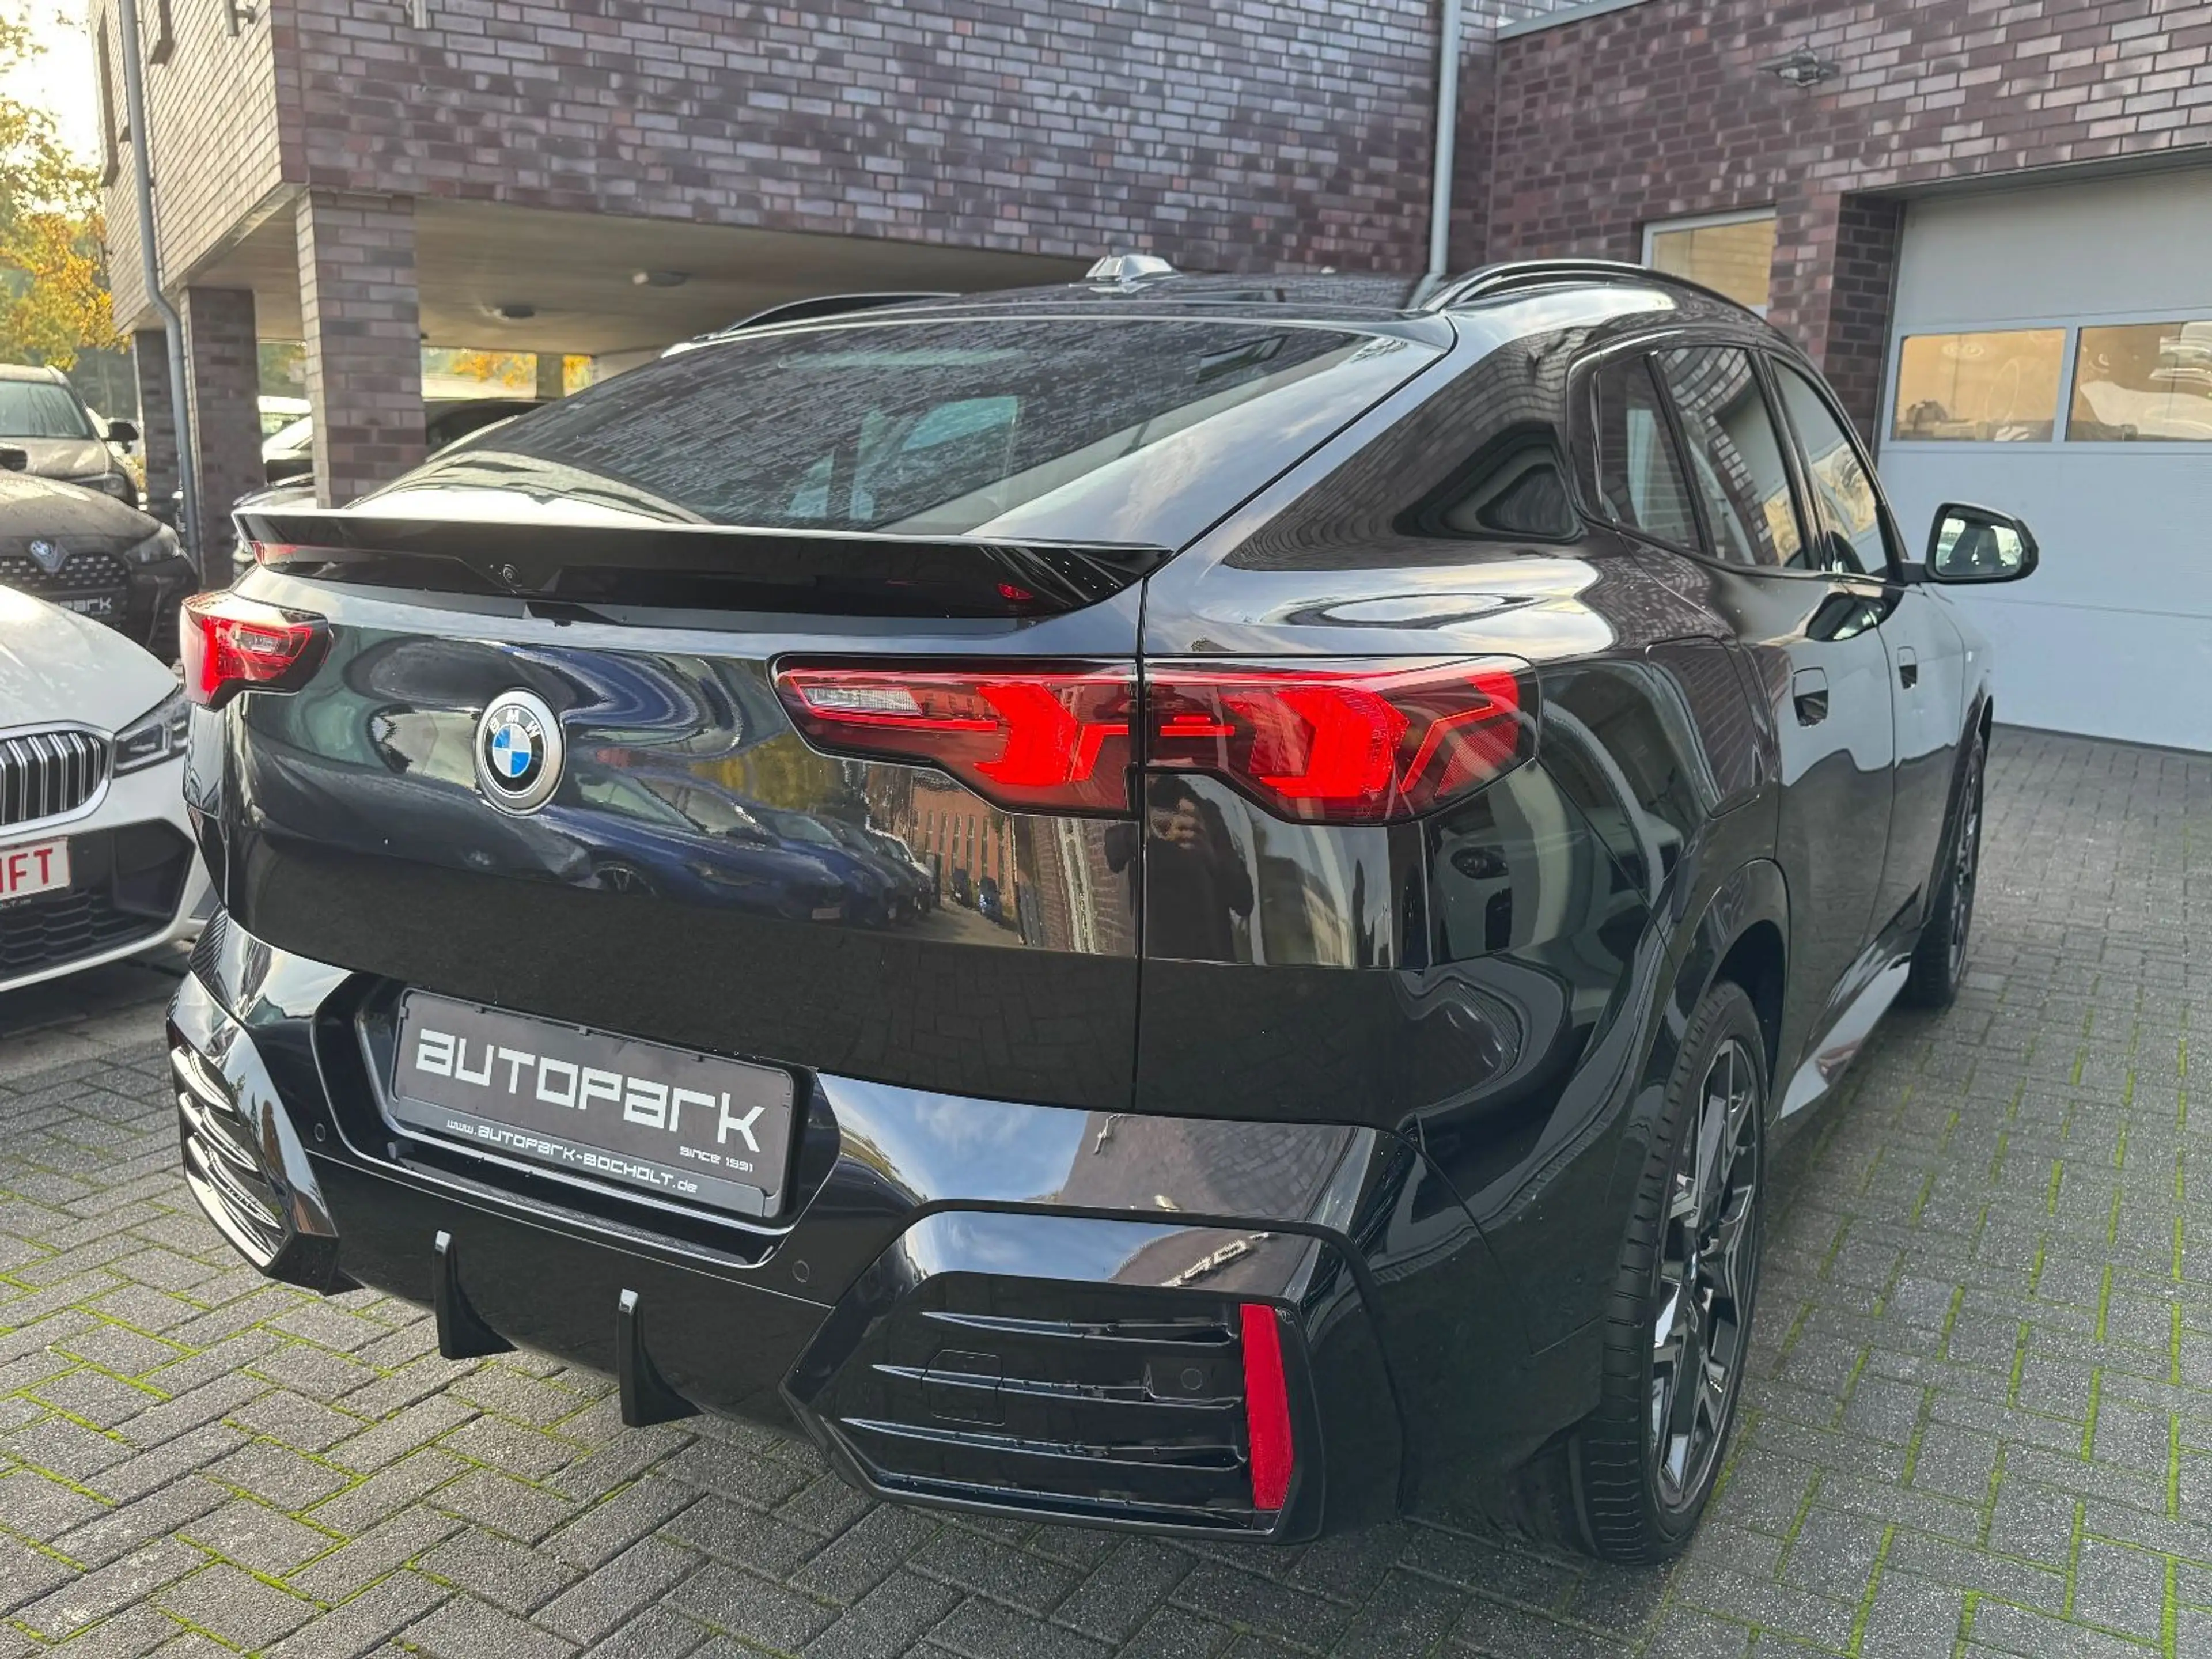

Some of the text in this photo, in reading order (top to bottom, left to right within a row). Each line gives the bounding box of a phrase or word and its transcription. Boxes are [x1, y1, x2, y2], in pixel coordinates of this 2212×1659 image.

[488, 709, 541, 738] BMW
[679, 1146, 753, 1172] since 1991
